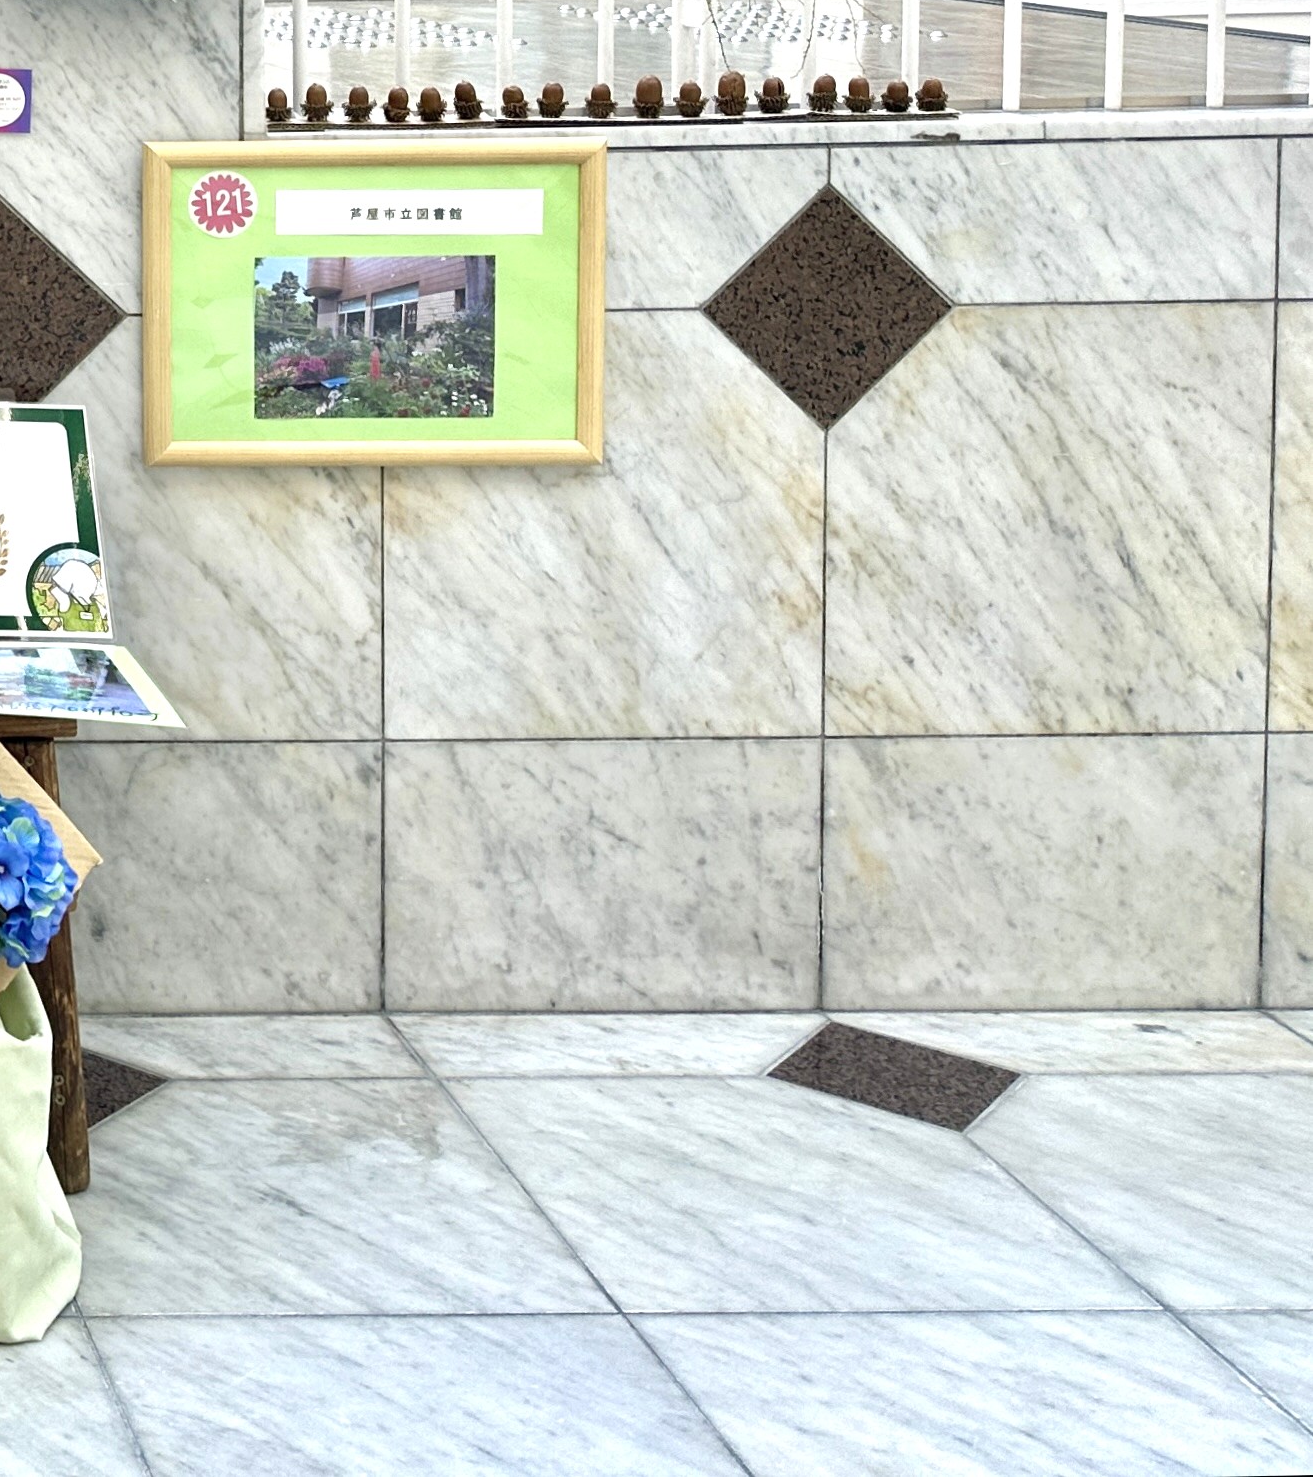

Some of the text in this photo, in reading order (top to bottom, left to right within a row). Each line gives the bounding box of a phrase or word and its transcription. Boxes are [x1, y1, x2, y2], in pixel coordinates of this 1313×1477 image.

[202, 188, 245, 217] 121
[350, 208, 462, 221] 芦屋市立図書館
